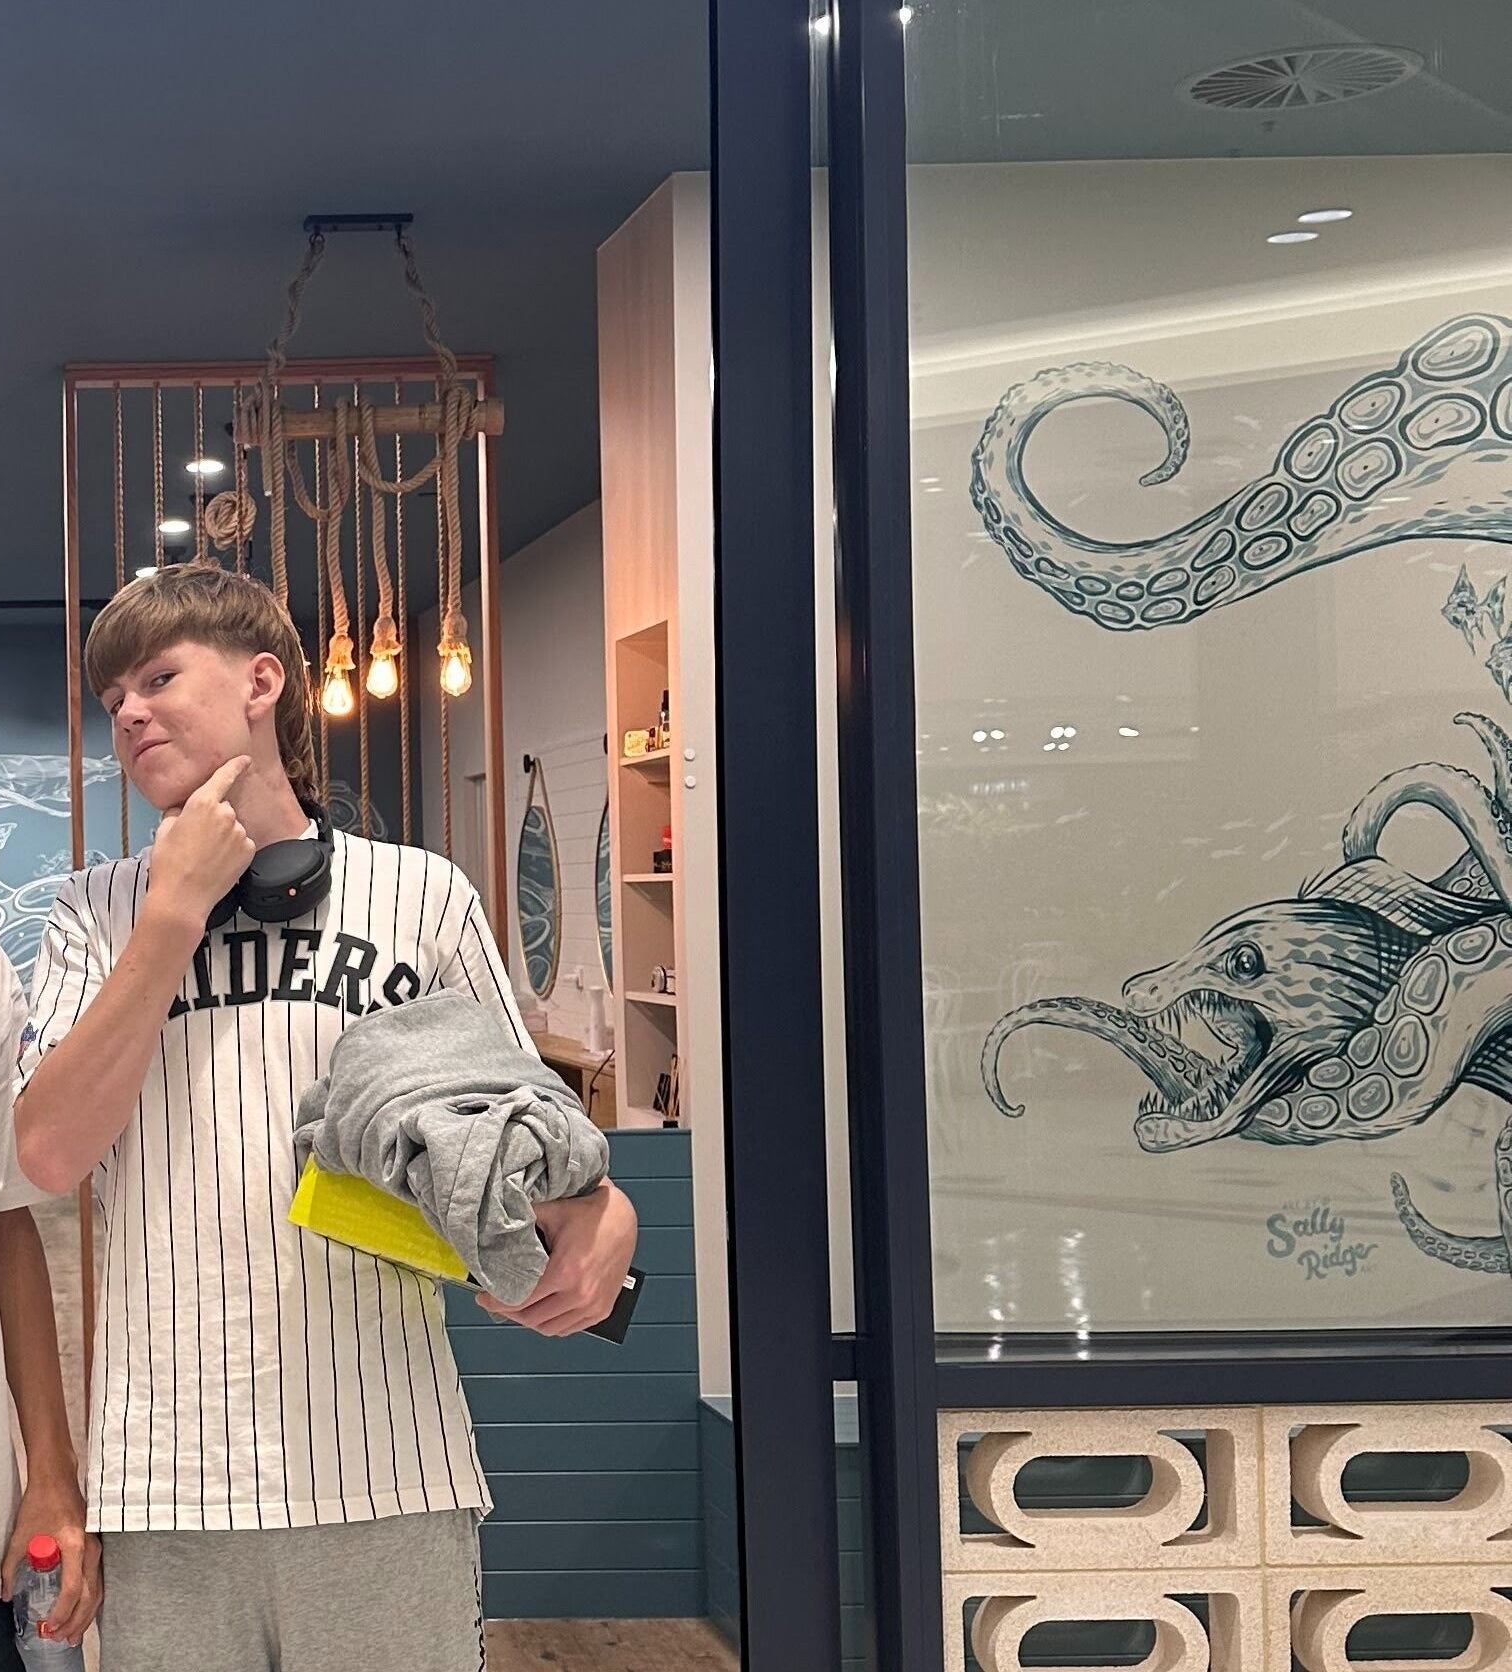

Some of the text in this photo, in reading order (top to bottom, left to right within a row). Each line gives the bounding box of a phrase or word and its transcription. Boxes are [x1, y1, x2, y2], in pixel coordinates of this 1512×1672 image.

[169, 927, 422, 1021] IDERS
[1265, 1206, 1345, 1259] Sally
[1296, 1242, 1379, 1281] Ridge
